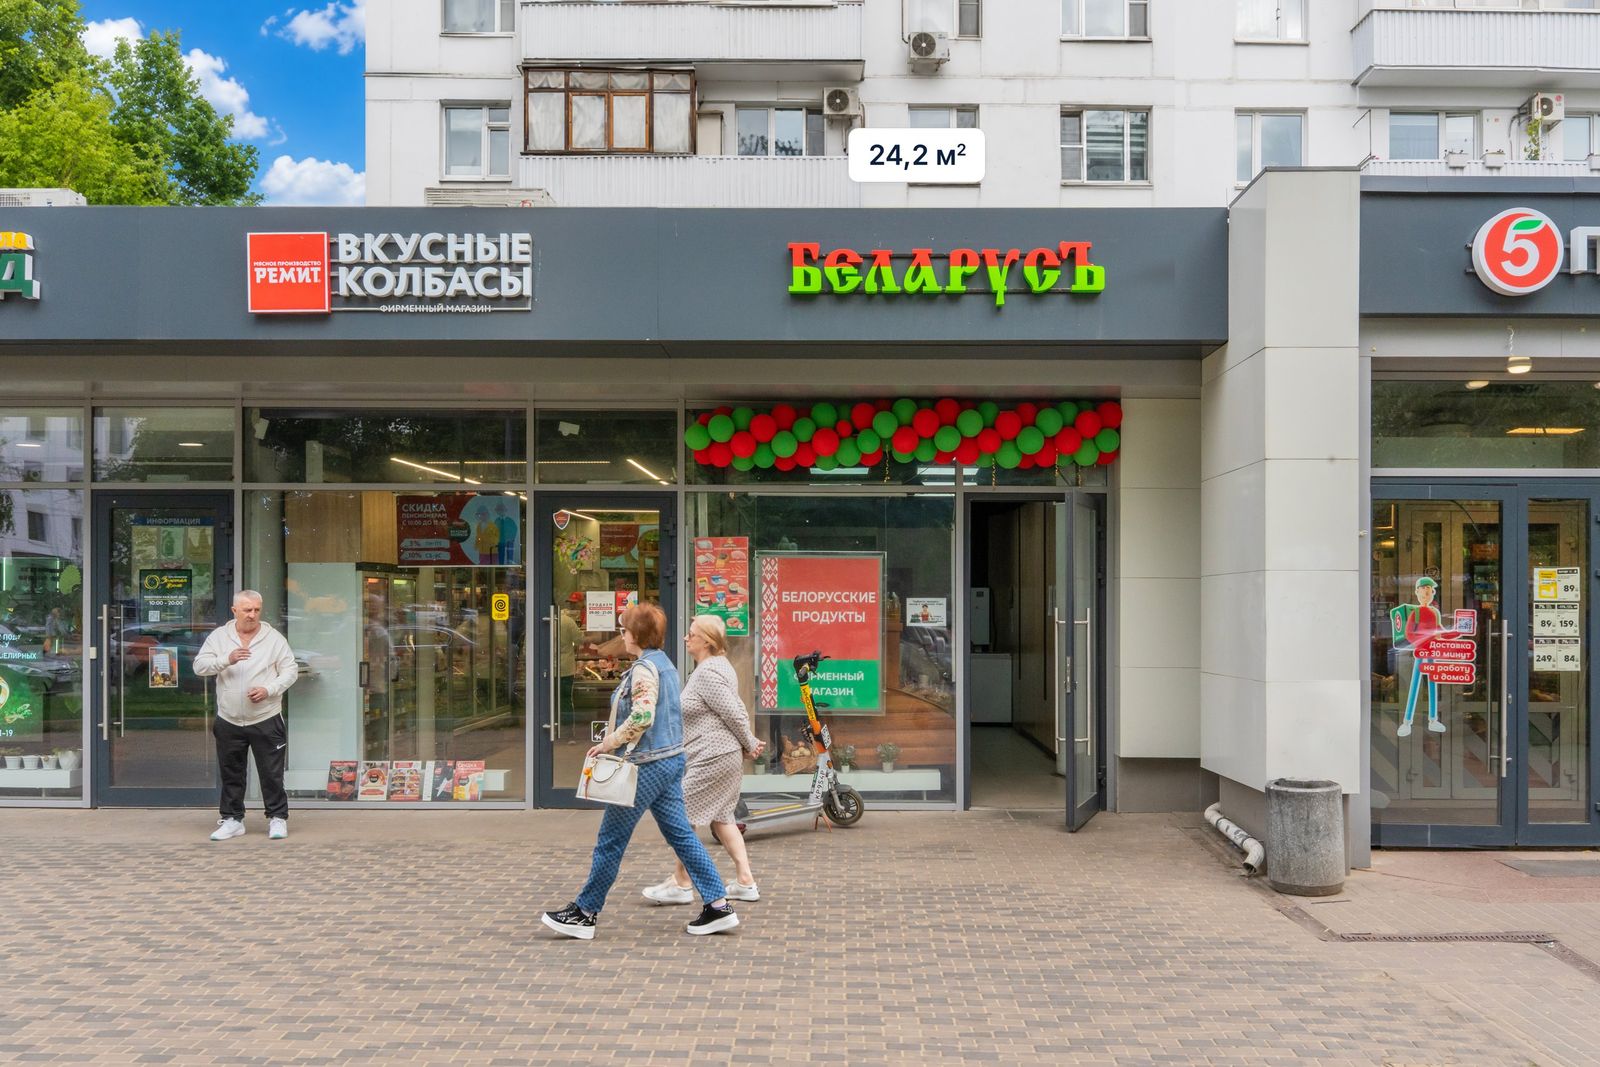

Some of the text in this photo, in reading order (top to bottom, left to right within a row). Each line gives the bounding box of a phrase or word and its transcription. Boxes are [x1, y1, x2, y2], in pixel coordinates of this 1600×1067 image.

[338, 232, 532, 264] ВКУСНЫЕ
[1500, 215, 1545, 277] 5
[254, 267, 321, 283] РЕМИТ
[338, 266, 532, 297] КОЛБАСЫ
[379, 303, 491, 313] ФИРМЕННЫЙ МАГАЗИН
[402, 504, 446, 513] СКИДКА
[146, 518, 201, 526] ИНФОРМАЦИЯ
[1563, 584, 1575, 592] 89
[781, 591, 877, 604] БЕЛОРУССКИЕ
[792, 611, 866, 625] ПРОДУКТЫ
[1540, 619, 1552, 627] 89
[1559, 619, 1574, 627] 159
[1429, 641, 1472, 650] Доставка
[1442, 651, 1472, 659] минут
[1536, 654, 1552, 662] 249
[1564, 654, 1575, 662] 84
[1437, 663, 1470, 673] работу
[794, 671, 865, 681] РМЕННЫЙ
[1441, 673, 1470, 681] домой
[808, 687, 854, 697] АГАЗИН
